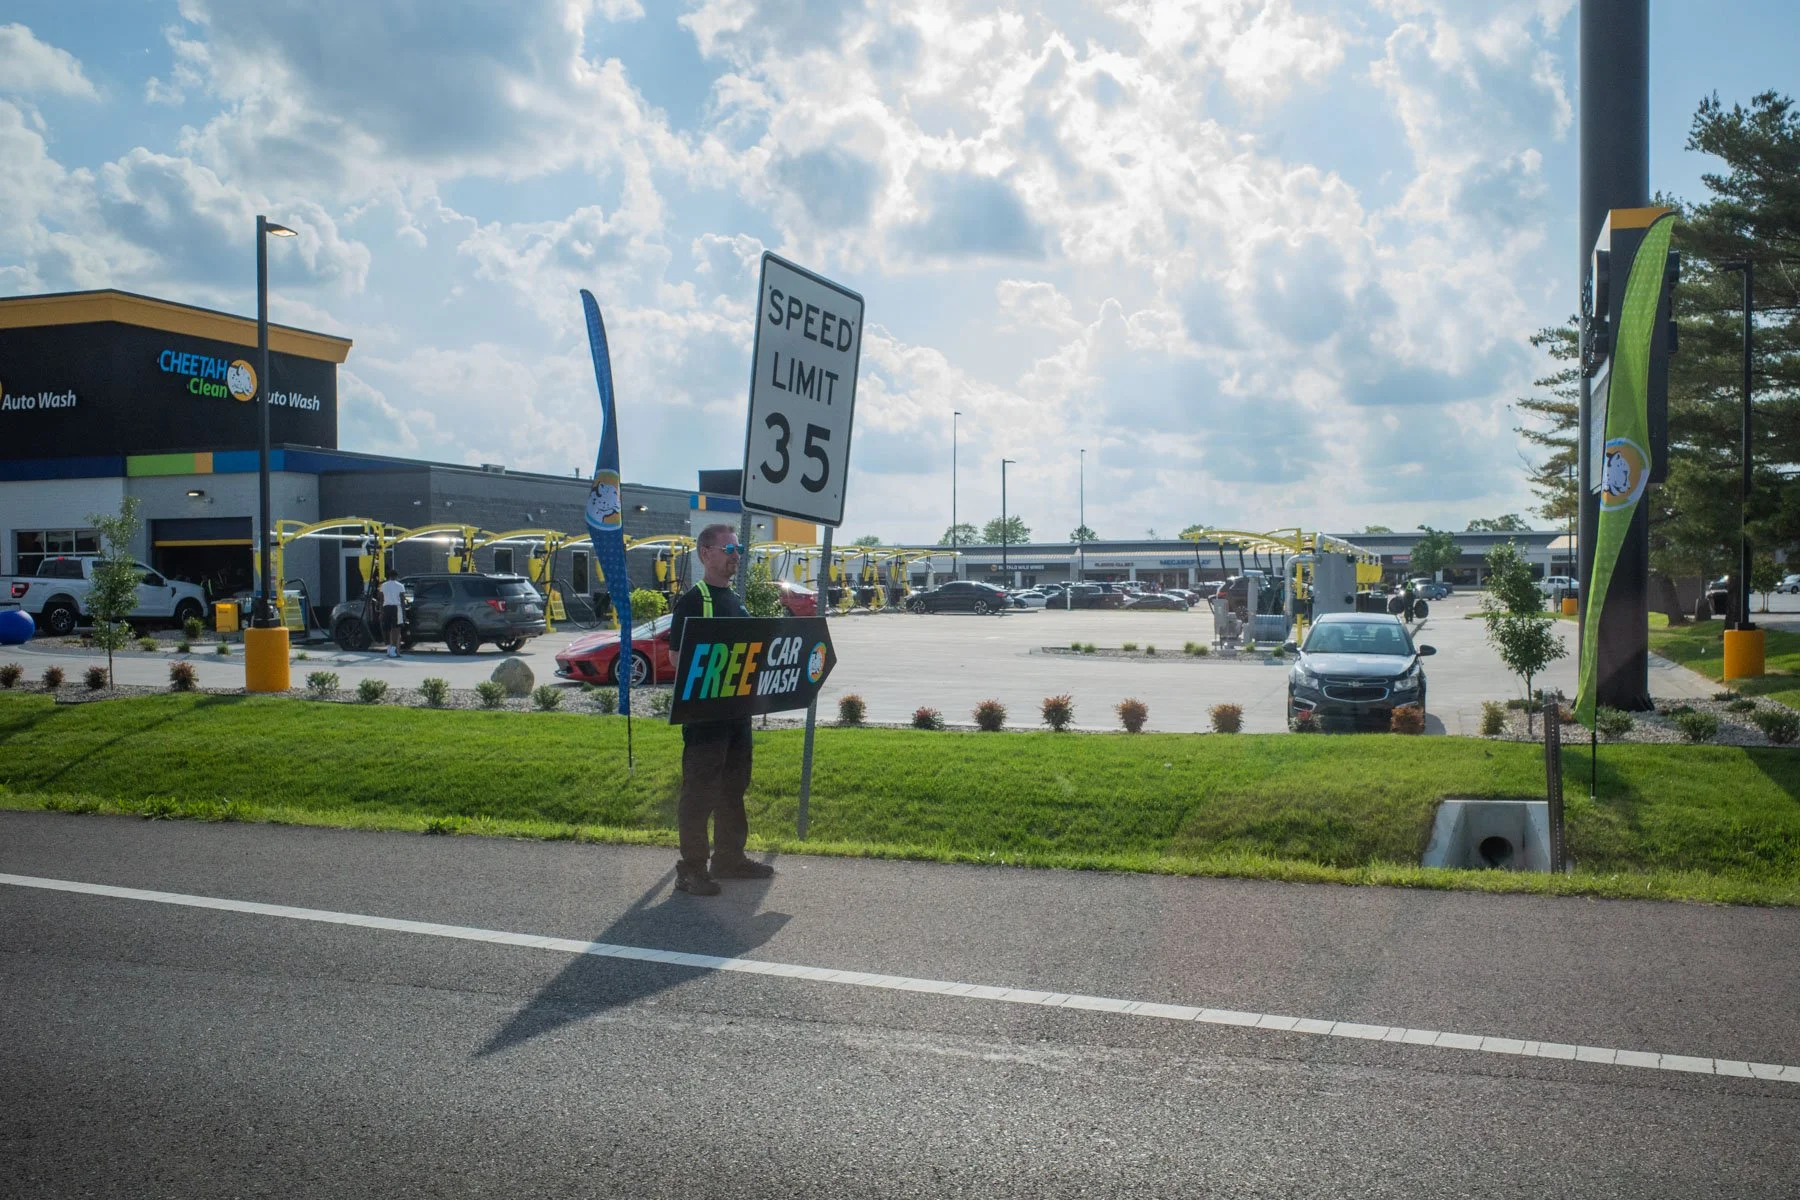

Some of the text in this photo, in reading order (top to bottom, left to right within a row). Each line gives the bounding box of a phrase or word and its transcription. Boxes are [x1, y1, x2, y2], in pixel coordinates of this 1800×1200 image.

[768, 288, 853, 353] SPEED
[159, 349, 228, 380] CHEETAH
[772, 351, 840, 406] LIMIT
[1, 389, 77, 410] Auto Wash
[189, 377, 228, 398] Clean
[256, 390, 320, 411] uto Wash
[760, 412, 831, 493] 35
[766, 636, 803, 667] CAR
[682, 642, 763, 700] FREE
[756, 667, 801, 696] WASH
